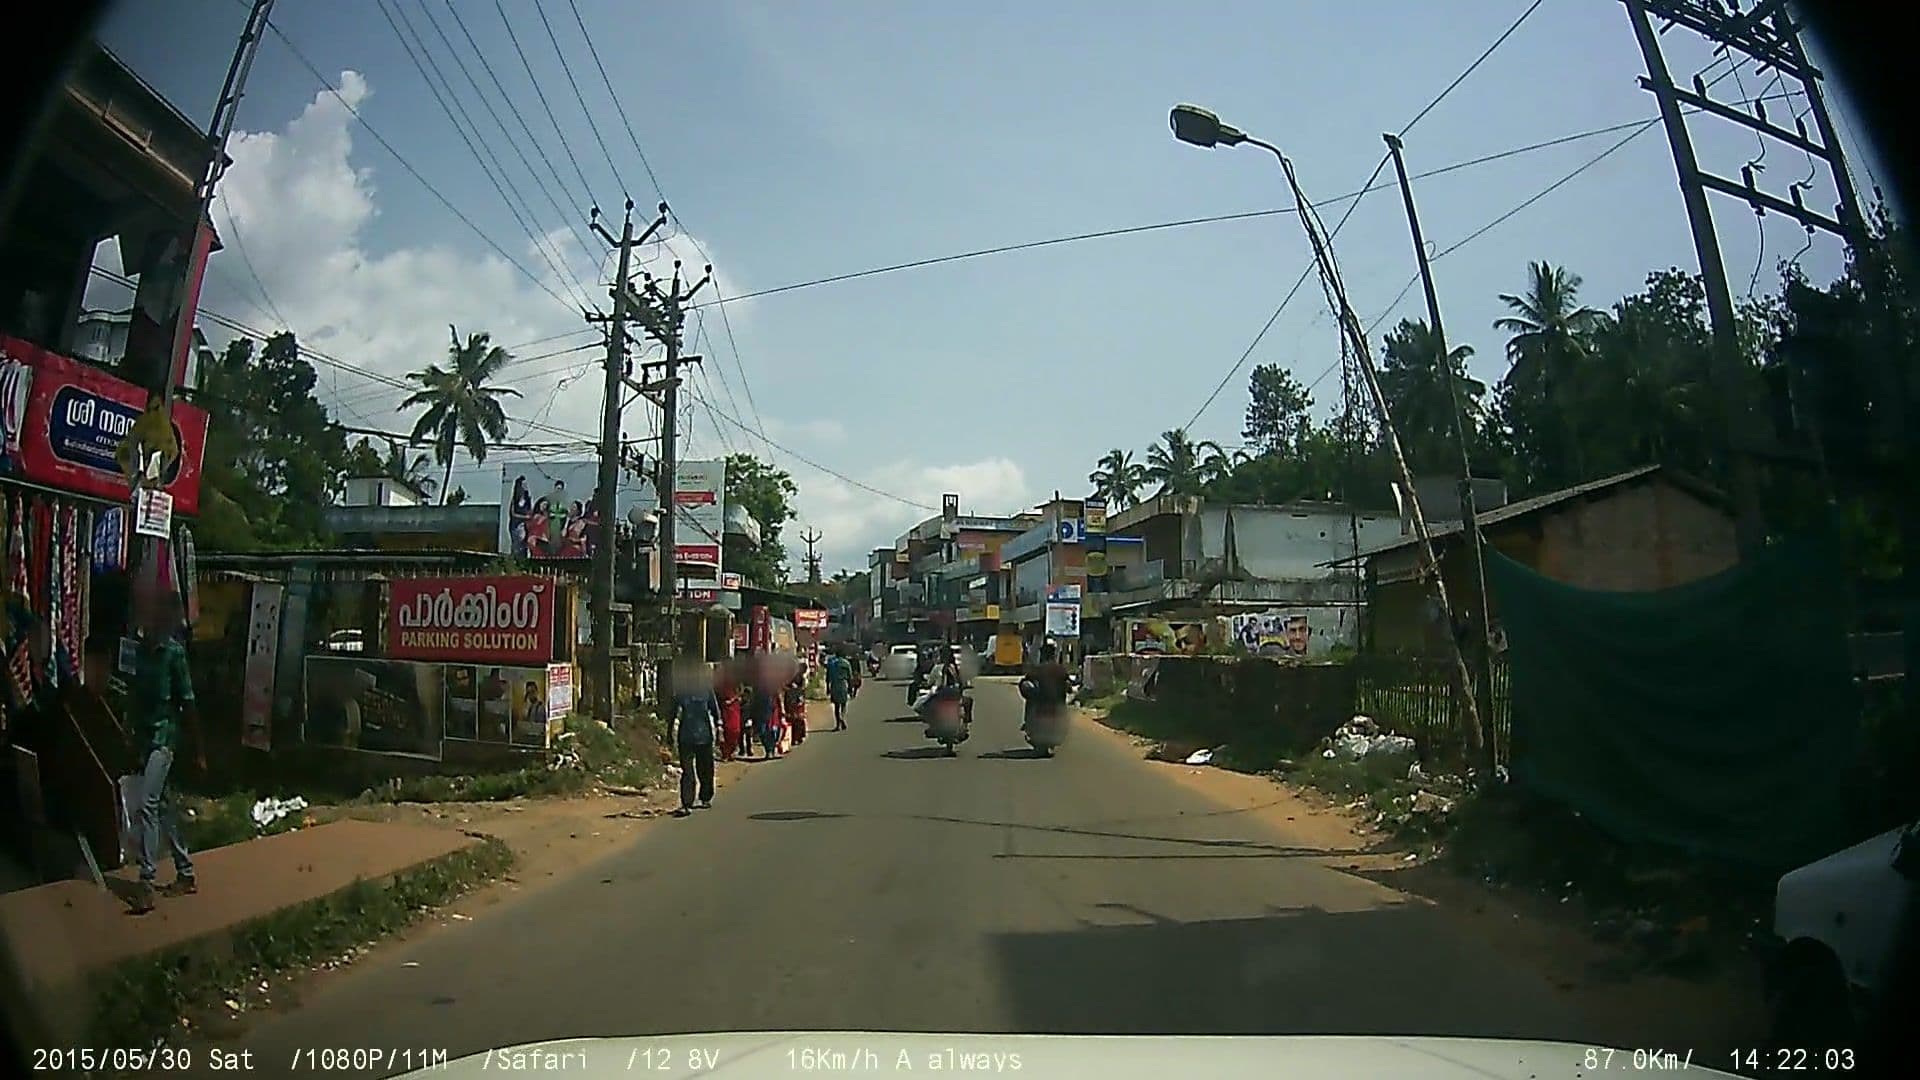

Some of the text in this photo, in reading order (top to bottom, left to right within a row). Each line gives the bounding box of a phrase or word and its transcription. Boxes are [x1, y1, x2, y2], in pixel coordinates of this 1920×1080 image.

[66, 399, 95, 427] ശ്രീ
[399, 585, 545, 629] പാർക്കിംഗ്
[401, 631, 538, 650] PARKING SOLUTION
